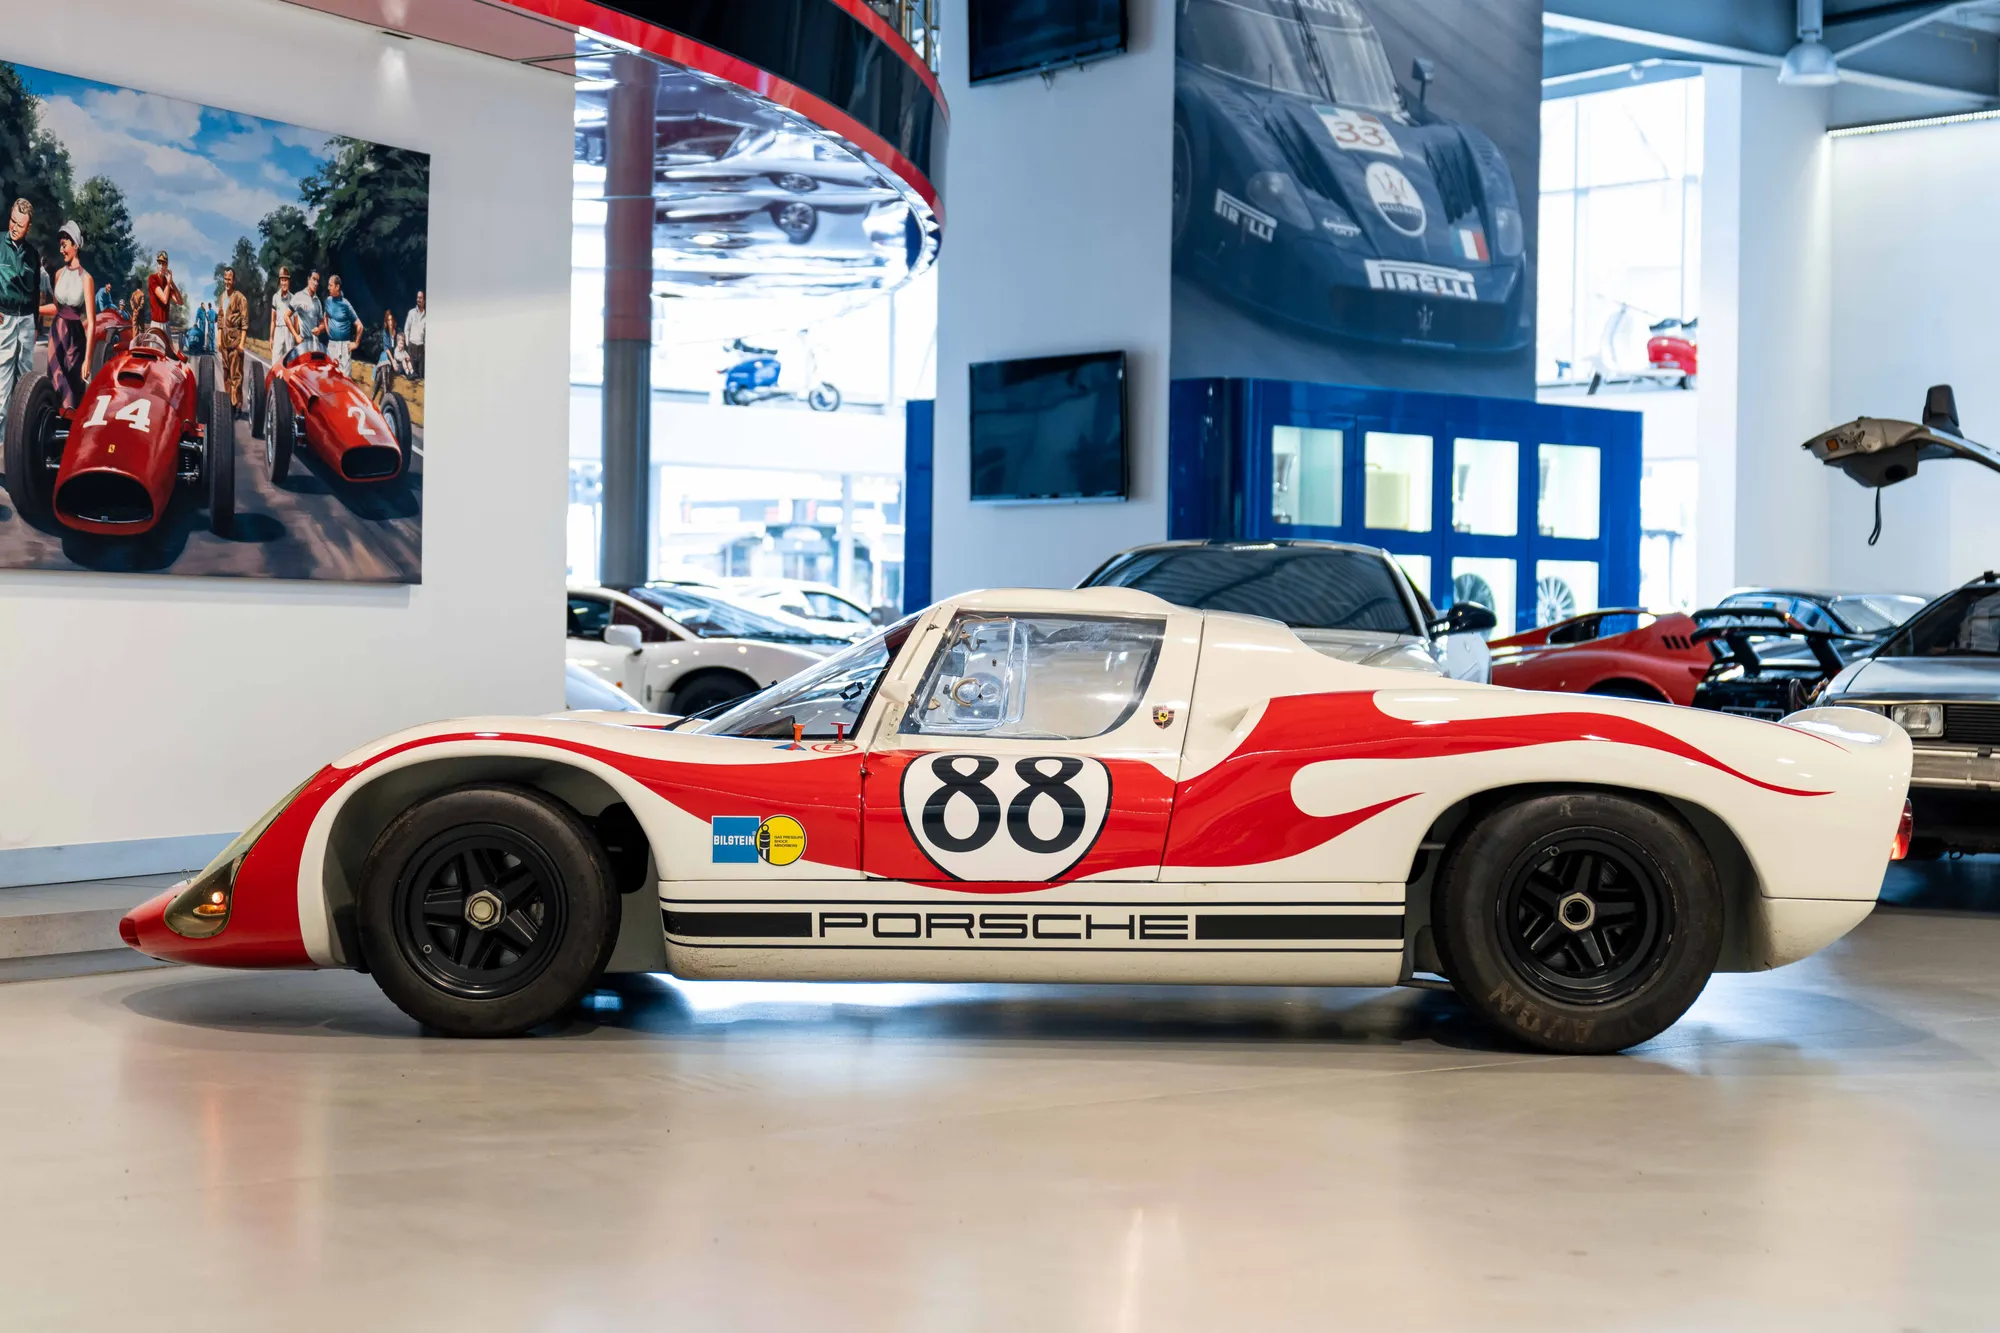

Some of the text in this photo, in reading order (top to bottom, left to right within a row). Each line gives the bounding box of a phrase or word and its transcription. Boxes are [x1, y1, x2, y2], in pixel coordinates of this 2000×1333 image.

[1333, 121, 1385, 147] 33
[1363, 259, 1478, 301] PIRELLI
[83, 395, 151, 433] 14
[348, 406, 376, 436] 2
[822, 744, 844, 752] E
[922, 754, 1086, 854] 88
[713, 835, 755, 846] BILSTEIN
[819, 912, 1189, 940] PORSCHE
[1487, 980, 1597, 1044] AVON
